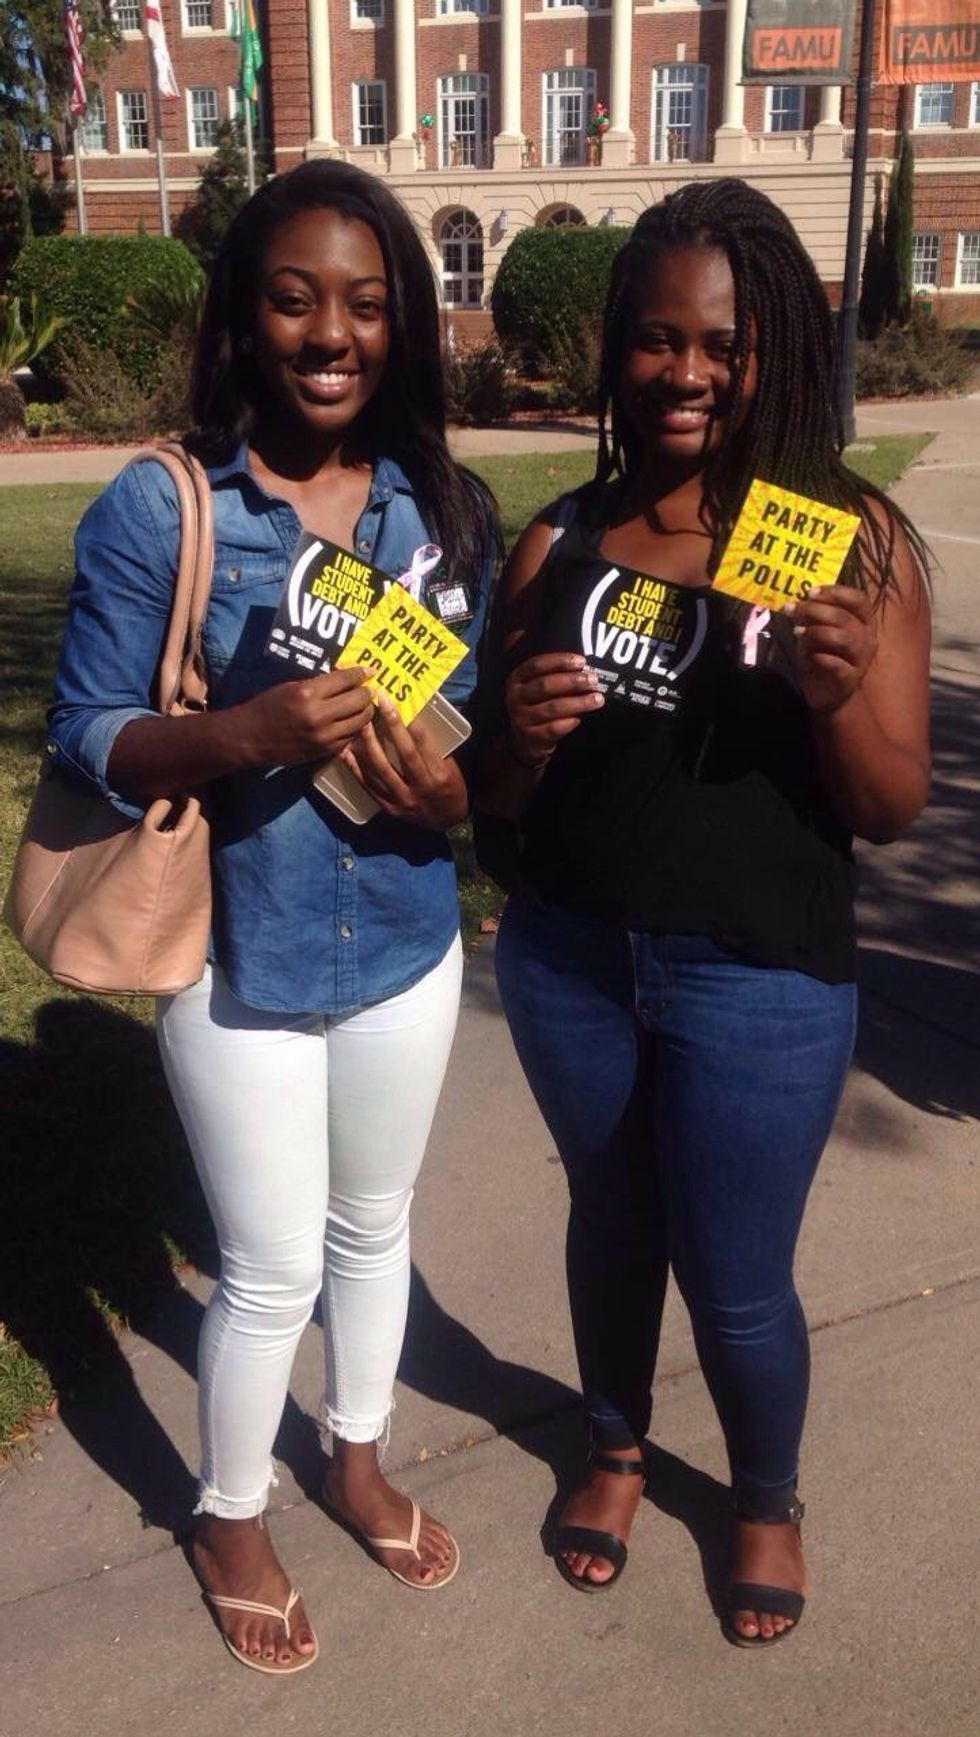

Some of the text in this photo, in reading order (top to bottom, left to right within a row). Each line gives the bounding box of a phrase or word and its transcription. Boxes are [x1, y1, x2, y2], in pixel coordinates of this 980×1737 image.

[758, 34, 836, 63] FAMU
[898, 29, 977, 61] FAMU
[761, 500, 837, 544] PARTY
[334, 552, 372, 586] I HAVE
[749, 530, 823, 573] AT THE
[311, 578, 370, 621] DEBT AND
[321, 564, 375, 605] STUDENT
[633, 577, 680, 606] I HAVE
[737, 557, 813, 600] POLLS
[302, 592, 361, 647] VOT
[606, 606, 646, 632] DEBT
[642, 619, 675, 642] AND
[618, 591, 683, 624] STUDENT
[390, 605, 448, 659] PARTY
[372, 628, 430, 681] AT THE
